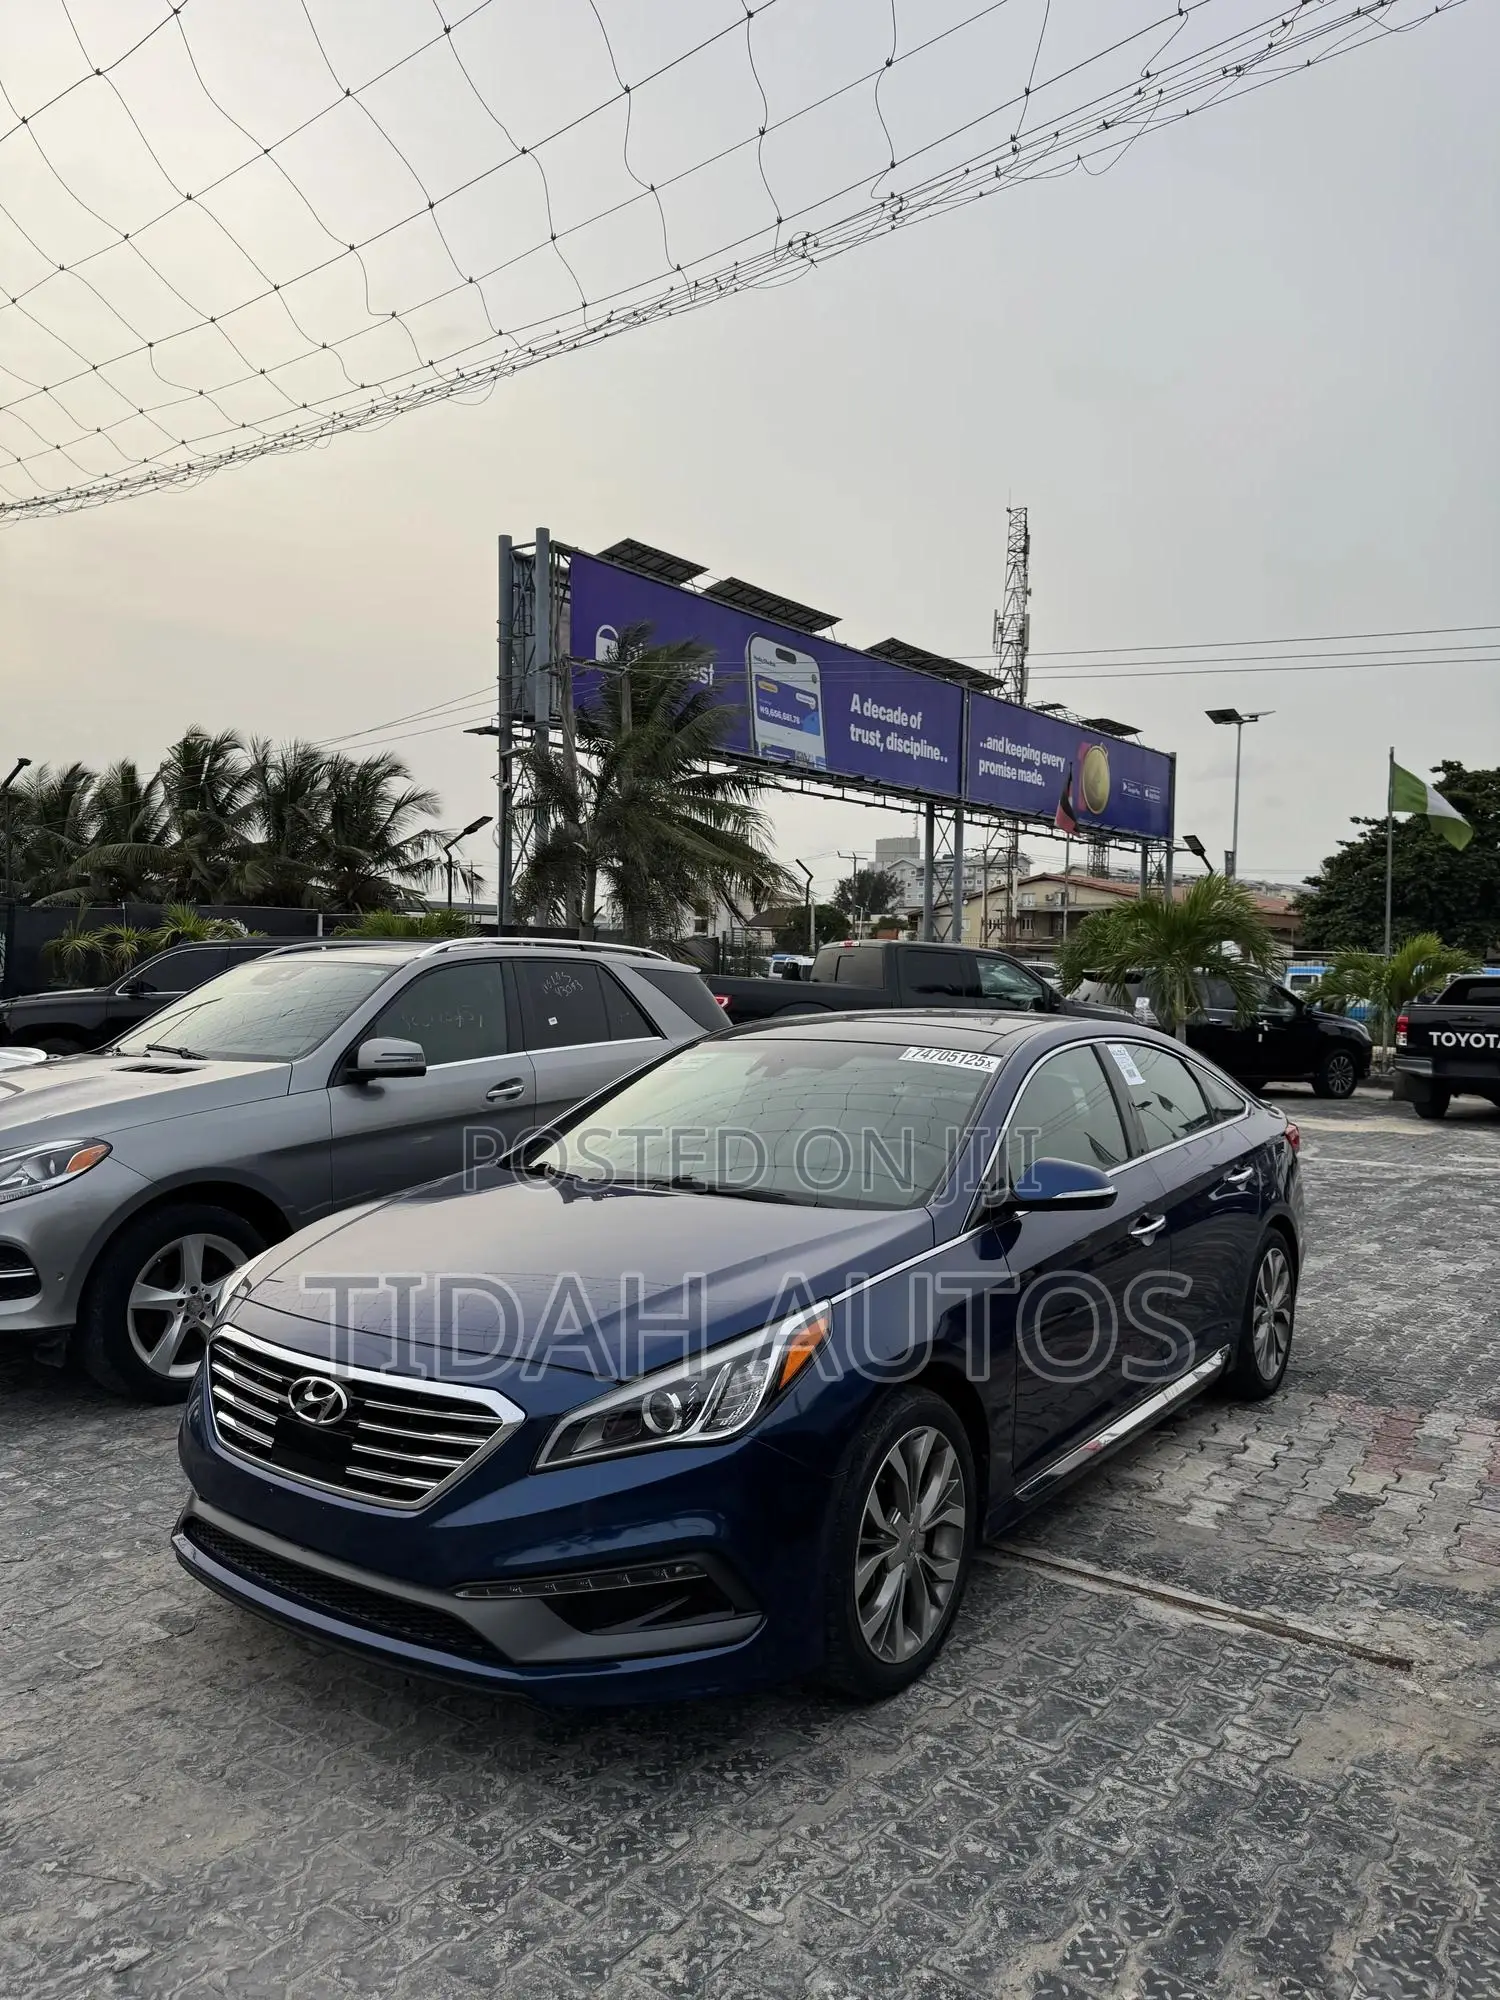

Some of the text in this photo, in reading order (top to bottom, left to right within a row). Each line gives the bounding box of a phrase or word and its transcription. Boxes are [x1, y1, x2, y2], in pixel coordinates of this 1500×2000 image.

[850, 693, 922, 730] A decade of
[850, 723, 948, 763] trust, discipline..
[1005, 738, 1040, 766] keeping
[1042, 752, 1066, 772] every
[979, 760, 1045, 787] promise made.
[1428, 1031, 1500, 1049] TOYOT
